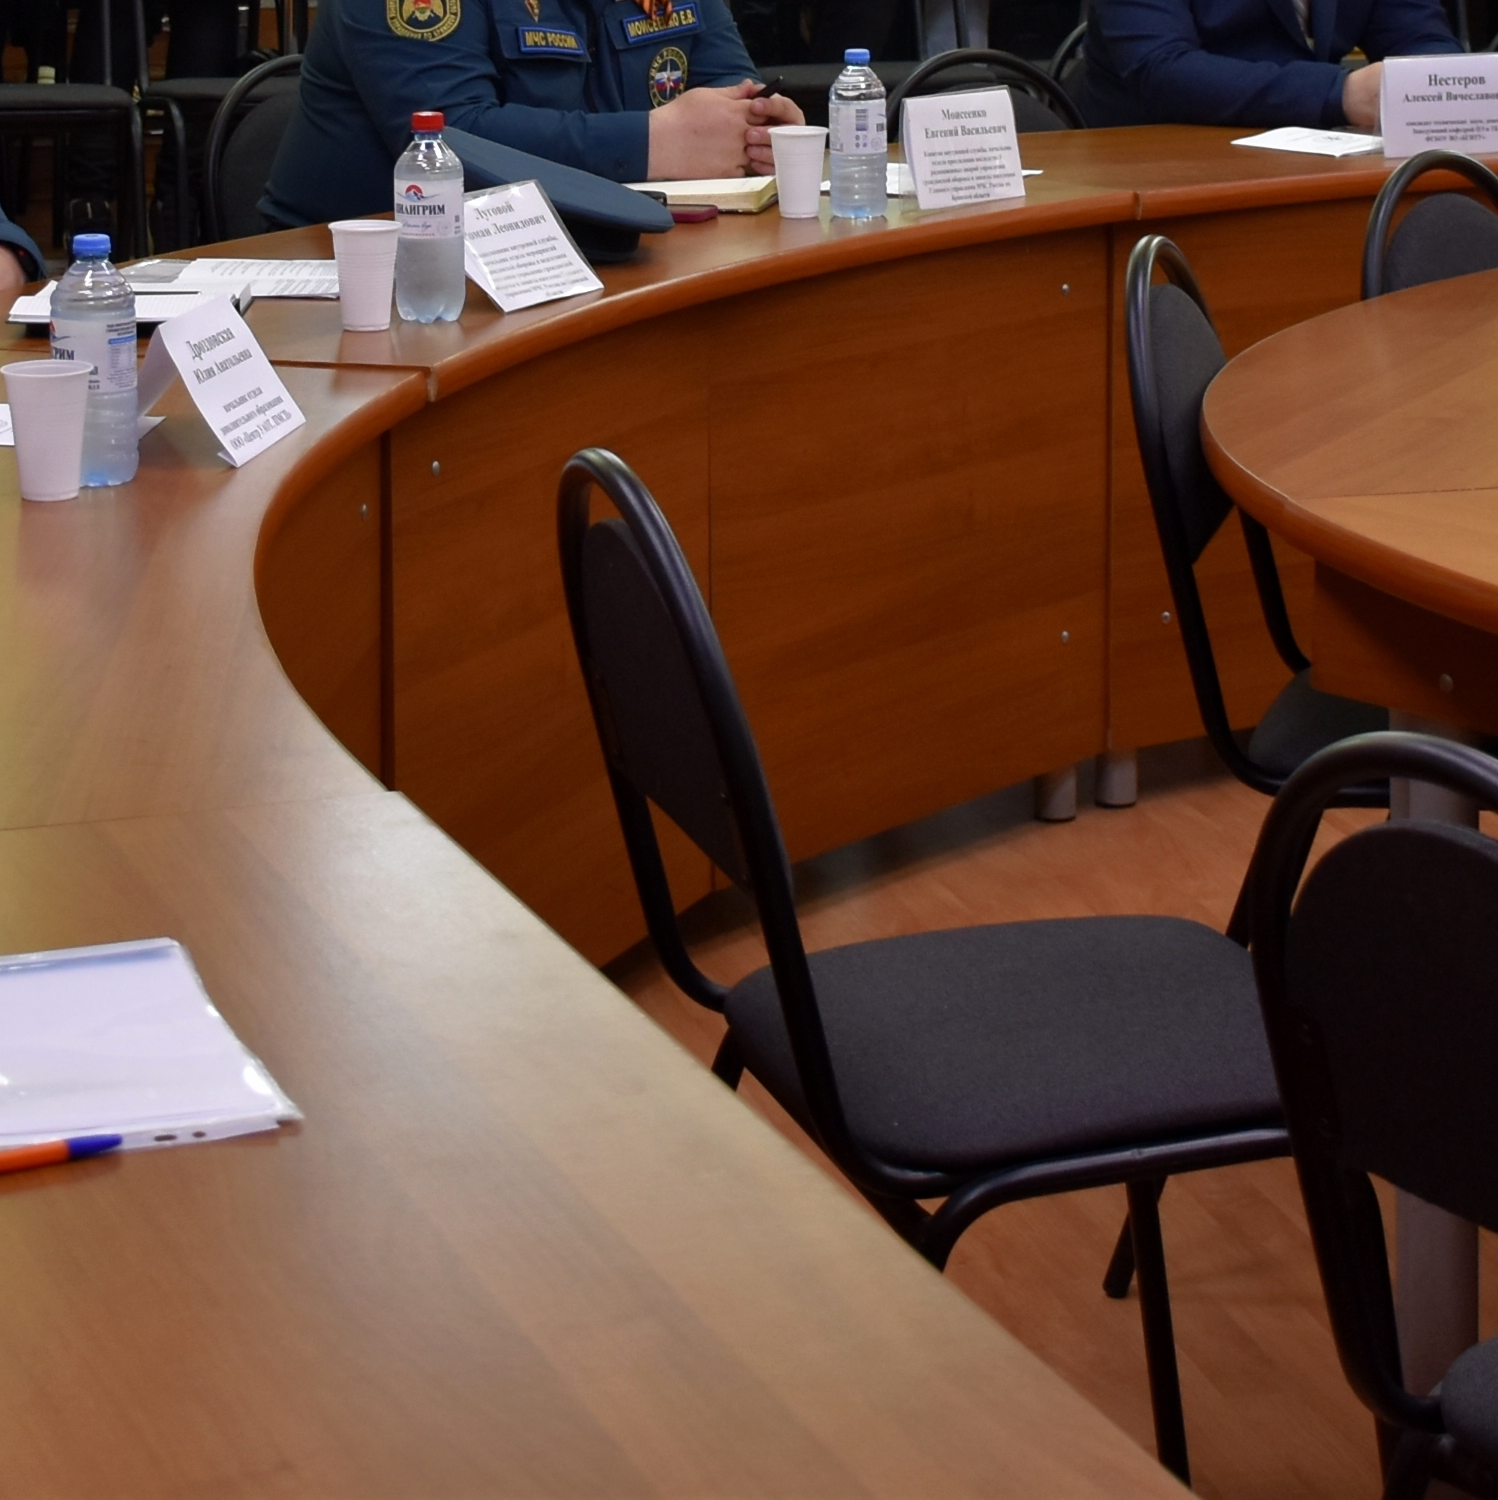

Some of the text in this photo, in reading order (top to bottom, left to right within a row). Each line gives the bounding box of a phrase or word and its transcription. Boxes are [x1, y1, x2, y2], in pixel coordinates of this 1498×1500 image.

[1428, 74, 1486, 88] Нестеров
[1403, 92, 1443, 103] Алексей
[941, 109, 987, 120] Моисеенко
[924, 125, 1007, 139] Евгений Васильевич
[473, 201, 515, 221] Луговой
[493, 214, 548, 235] Леонидович
[185, 327, 236, 361] Дроздовская
[193, 348, 253, 385] Юлия Анатольевна
